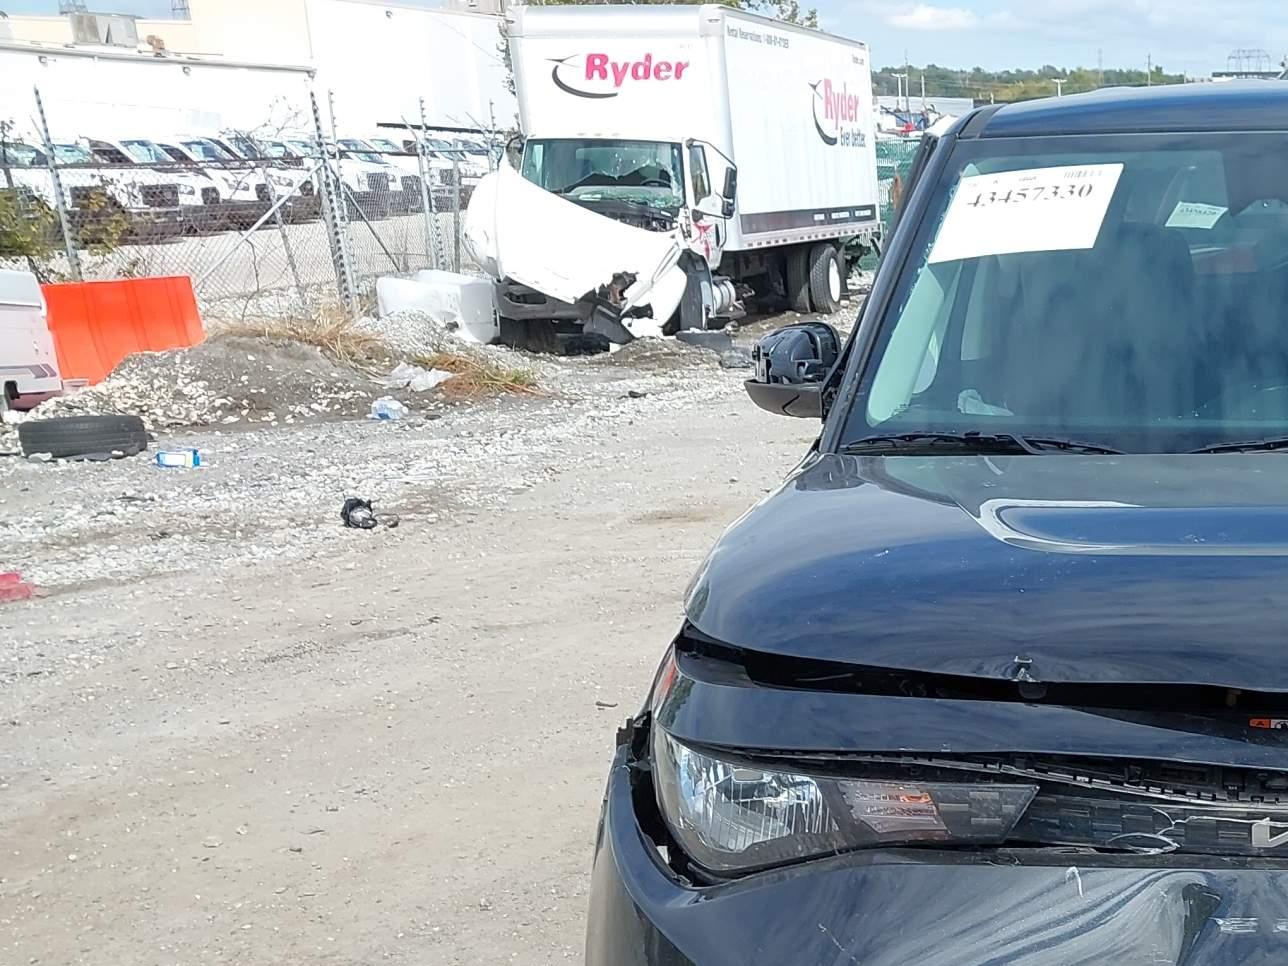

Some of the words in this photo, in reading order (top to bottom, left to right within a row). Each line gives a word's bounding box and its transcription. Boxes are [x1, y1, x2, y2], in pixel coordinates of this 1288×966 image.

[585, 53, 690, 88] Ryder
[824, 78, 860, 130] Ryder
[967, 184, 1093, 208] 43457330
